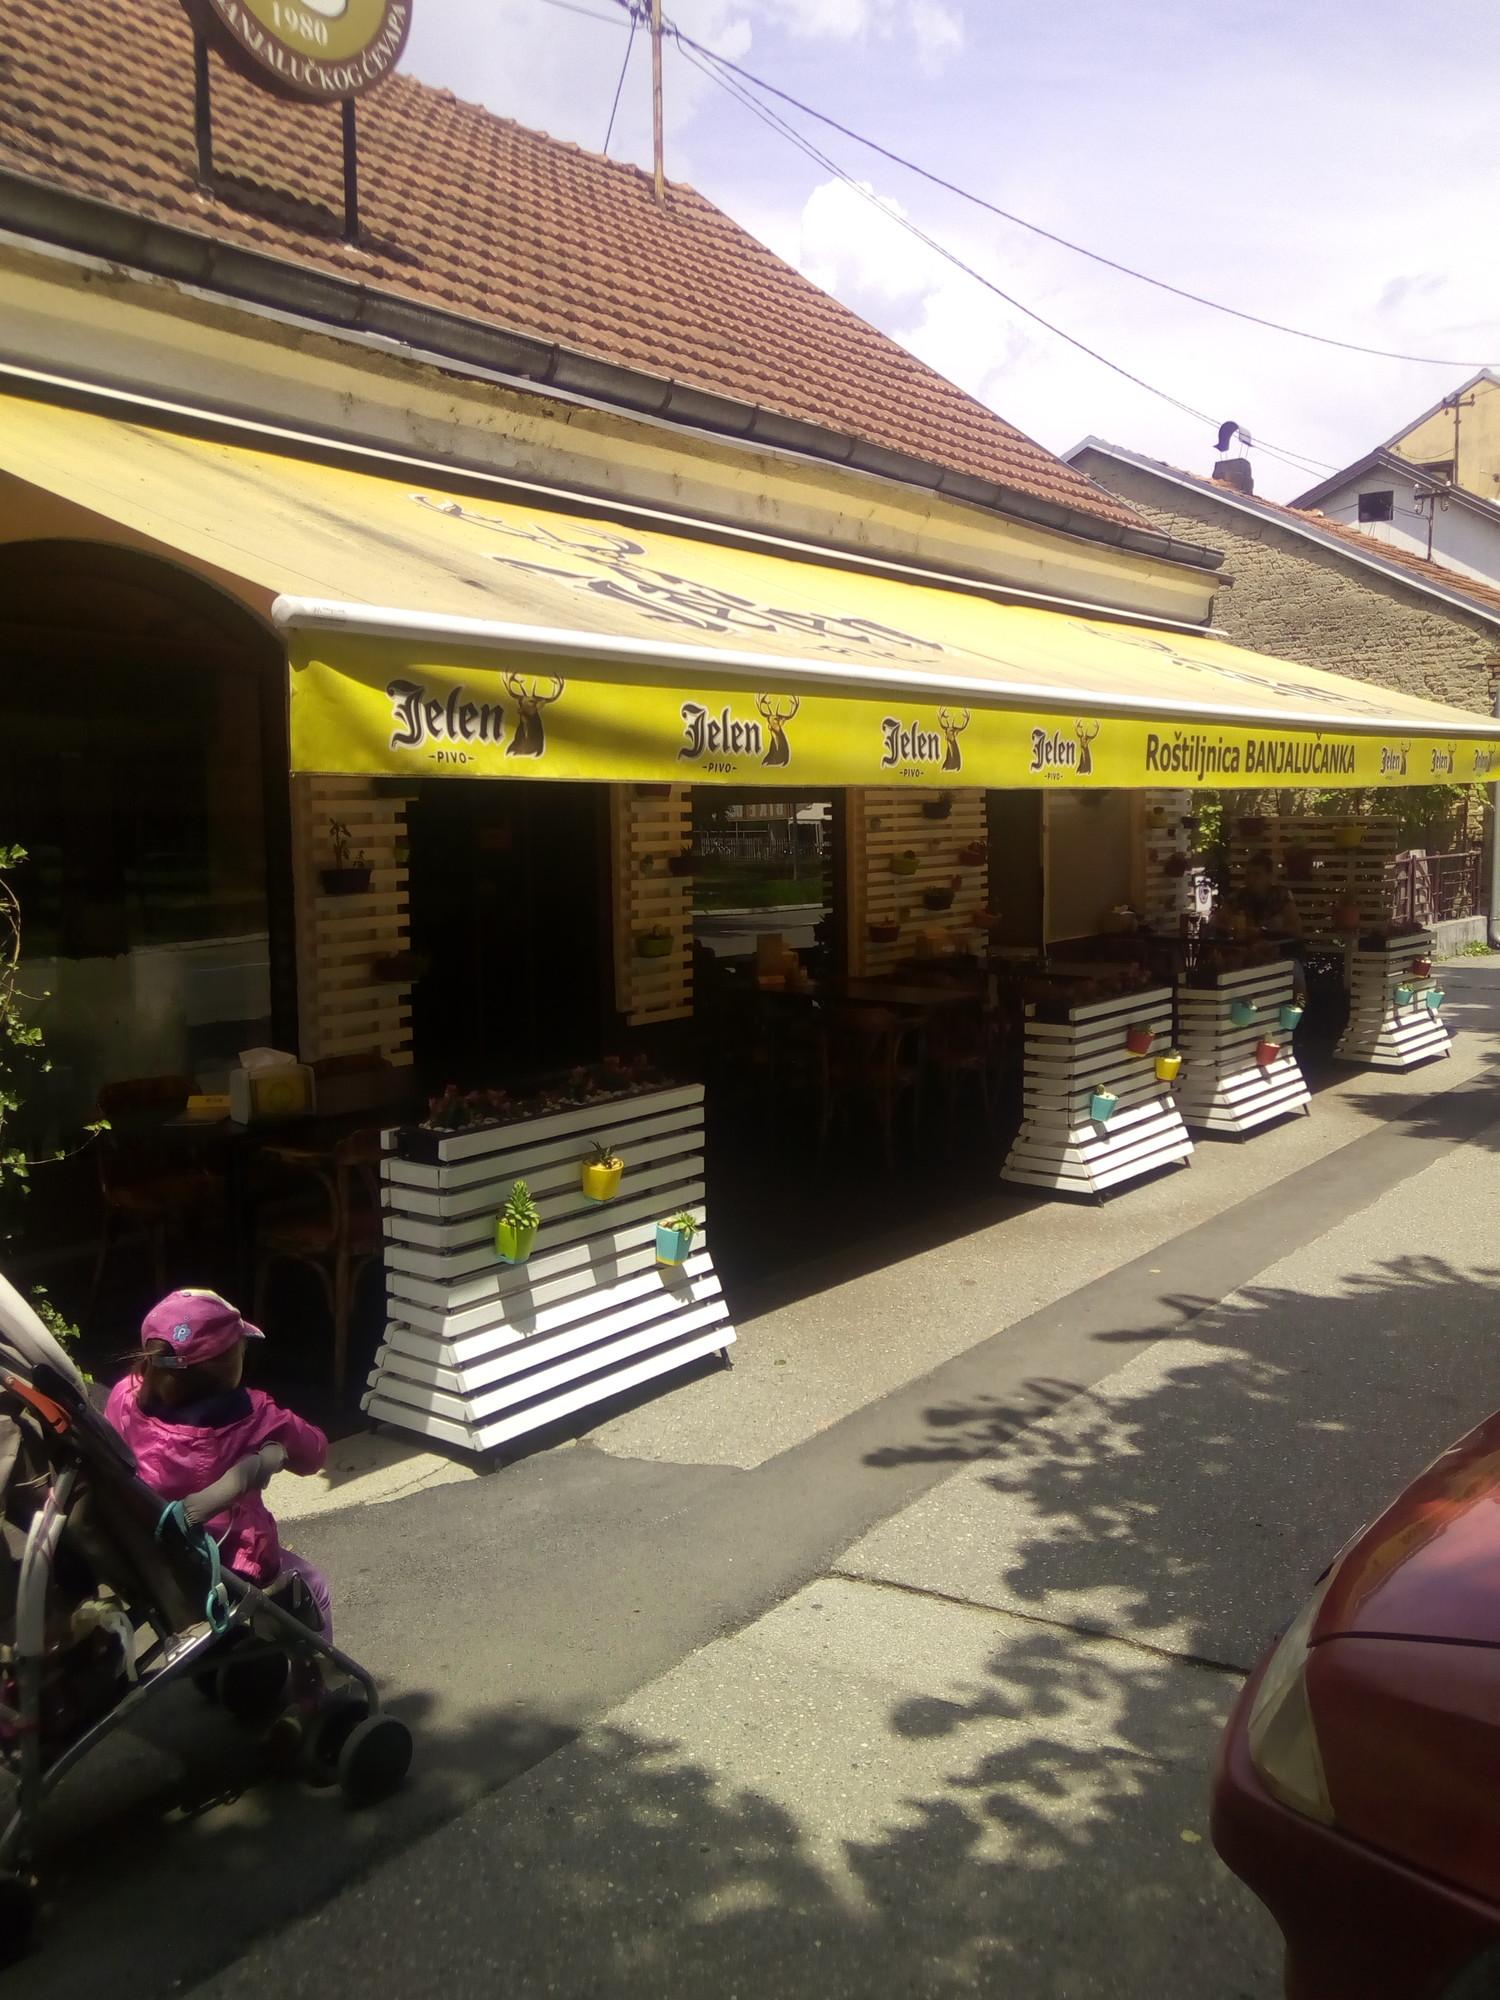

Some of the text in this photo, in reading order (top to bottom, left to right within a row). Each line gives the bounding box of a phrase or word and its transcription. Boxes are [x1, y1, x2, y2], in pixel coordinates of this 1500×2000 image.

[272, 1, 328, 47] 1980
[385, 679, 506, 748] Jelen
[677, 702, 762, 760] Jelen
[881, 717, 941, 768] Jelen
[1030, 729, 1076, 772] Jelen
[1145, 731, 1356, 782] Roštiljnica BANJALUČANKA
